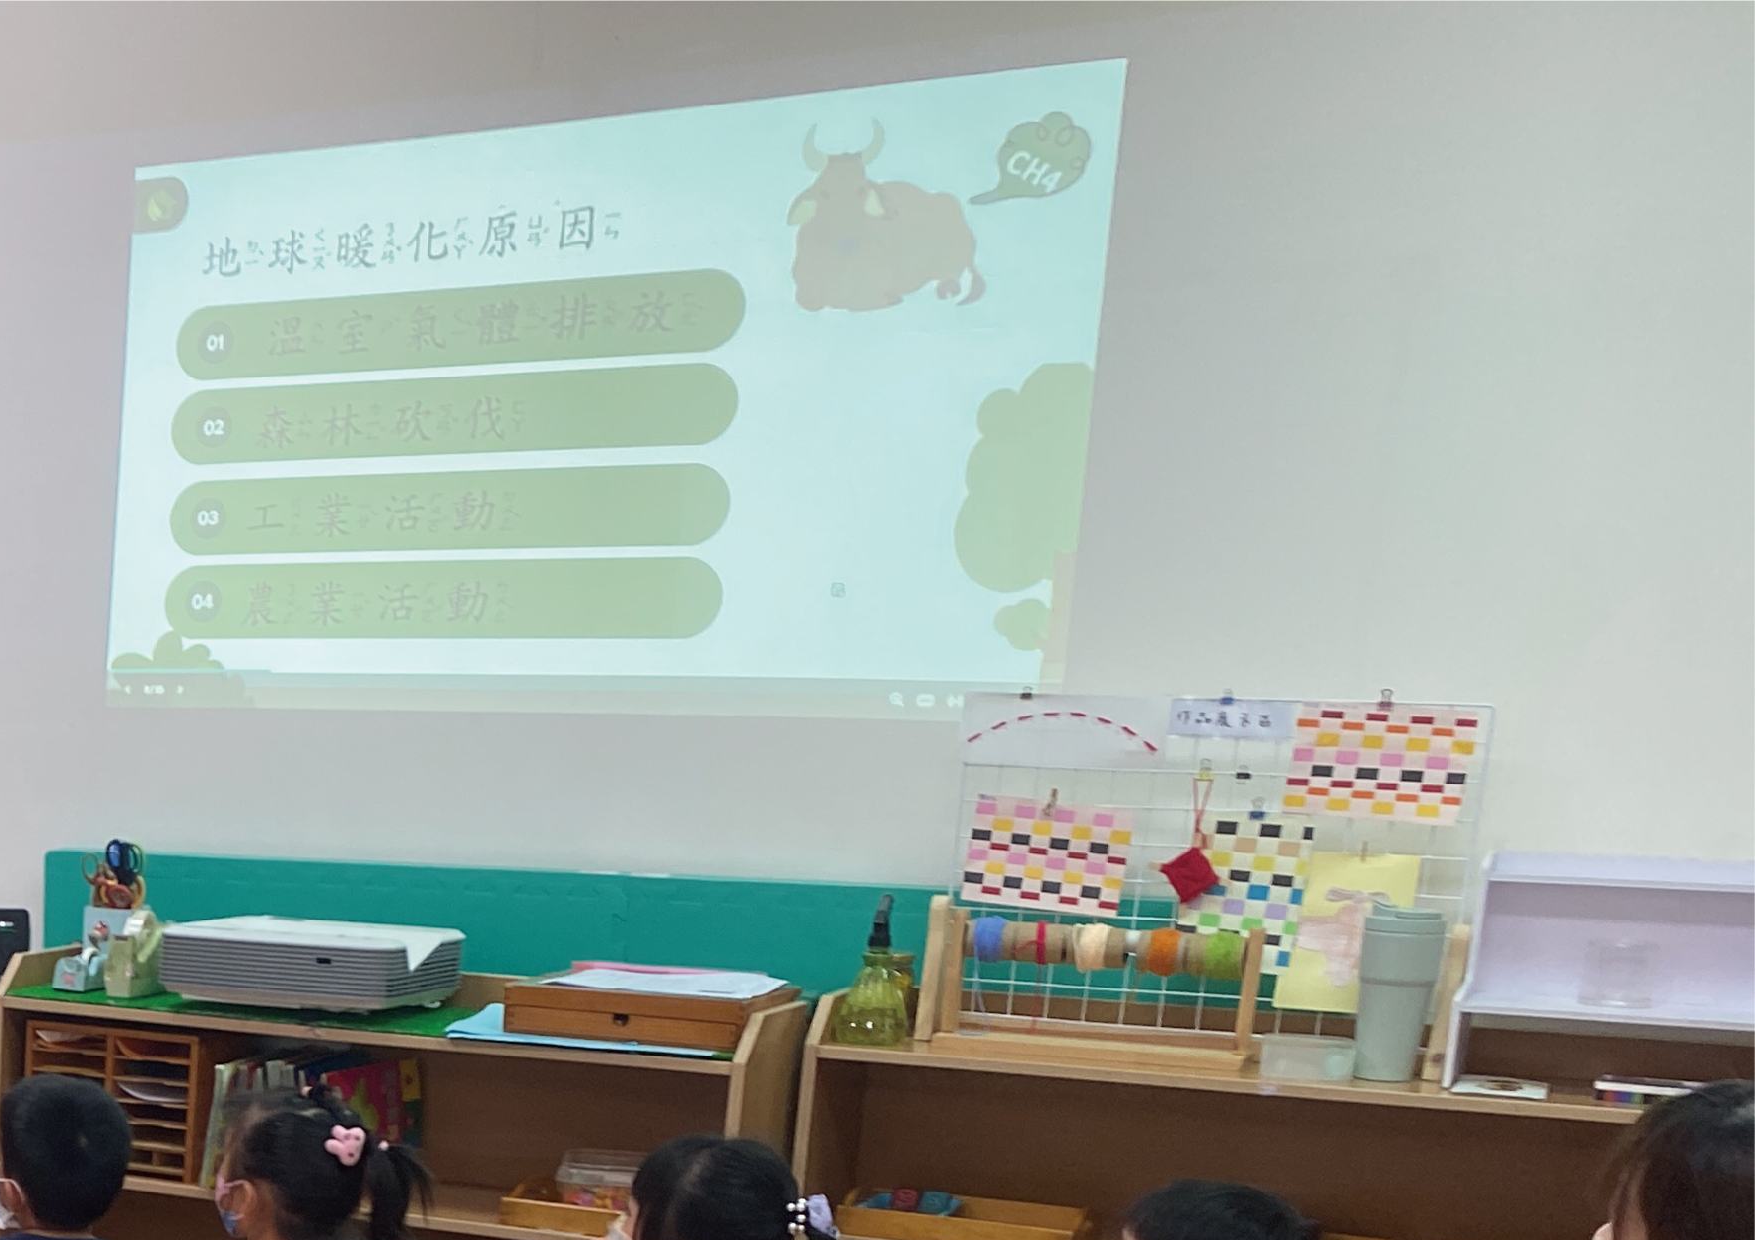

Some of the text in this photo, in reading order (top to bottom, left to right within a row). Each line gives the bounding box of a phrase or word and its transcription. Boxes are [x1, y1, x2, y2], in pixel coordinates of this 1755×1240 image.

[1007, 150, 1063, 193] CH4
[202, 204, 622, 277] 地球暖化原因
[207, 333, 226, 352] 01
[203, 395, 521, 450] 02 森林砍伐
[197, 490, 518, 538] 03 工業活動
[191, 580, 510, 627] 04 農業活動
